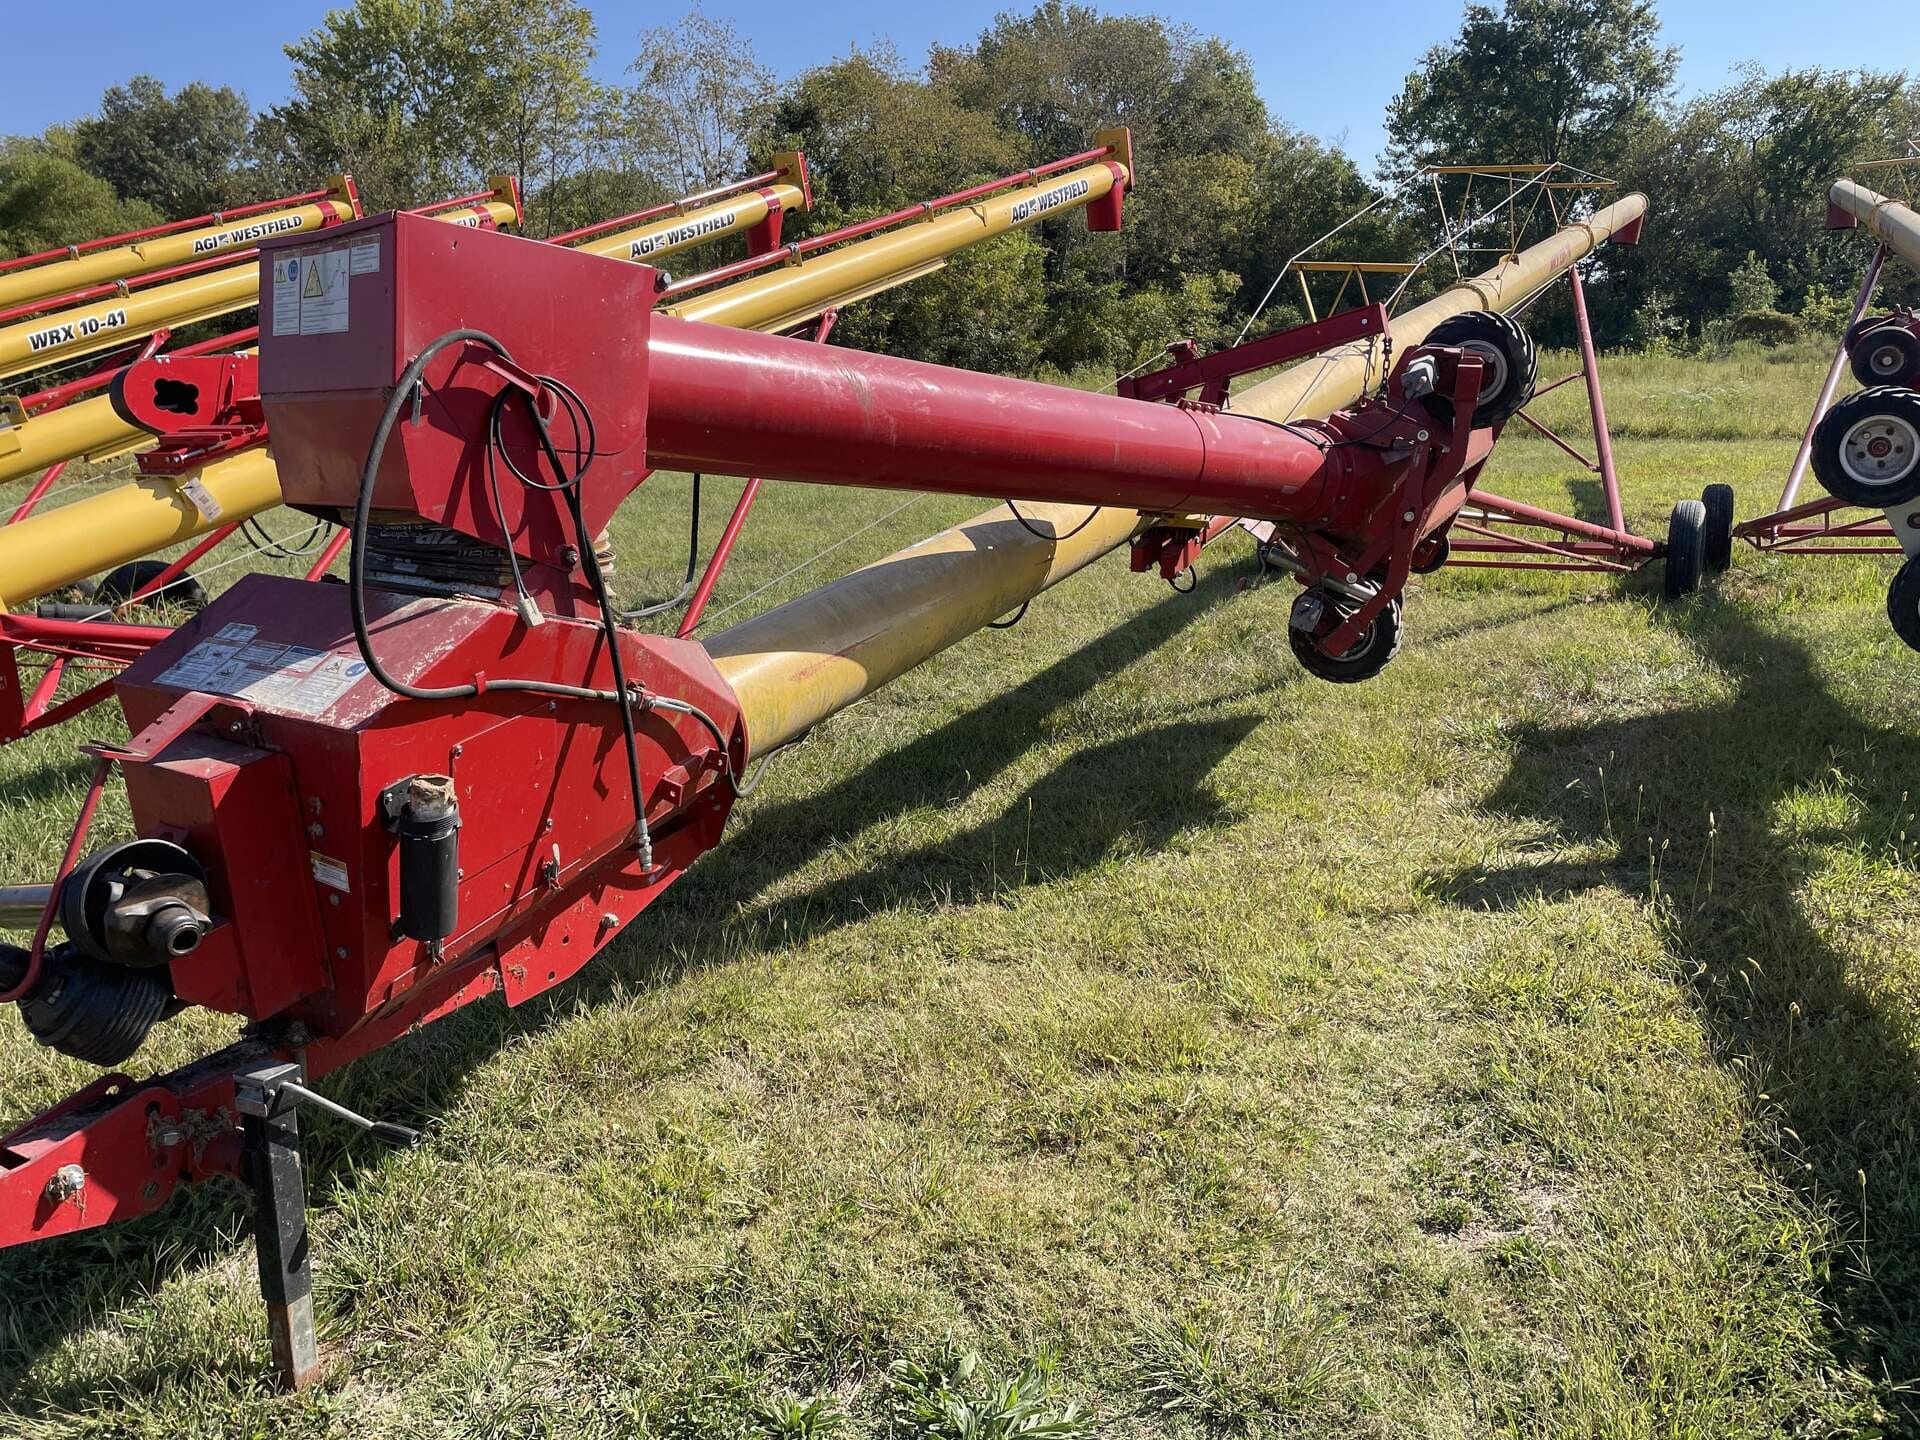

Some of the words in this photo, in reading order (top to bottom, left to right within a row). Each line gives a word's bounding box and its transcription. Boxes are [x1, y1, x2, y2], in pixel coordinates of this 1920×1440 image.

[1011, 203, 1029, 223] AGI
[1038, 179, 1089, 211] WESTFIELD
[194, 237, 218, 253] AGI
[231, 216, 302, 242] WESTFIELD
[631, 238, 655, 258] AGI
[667, 213, 735, 245] WESTFIELD
[29, 325, 75, 350] WRX
[80, 310, 126, 336] 10-41
